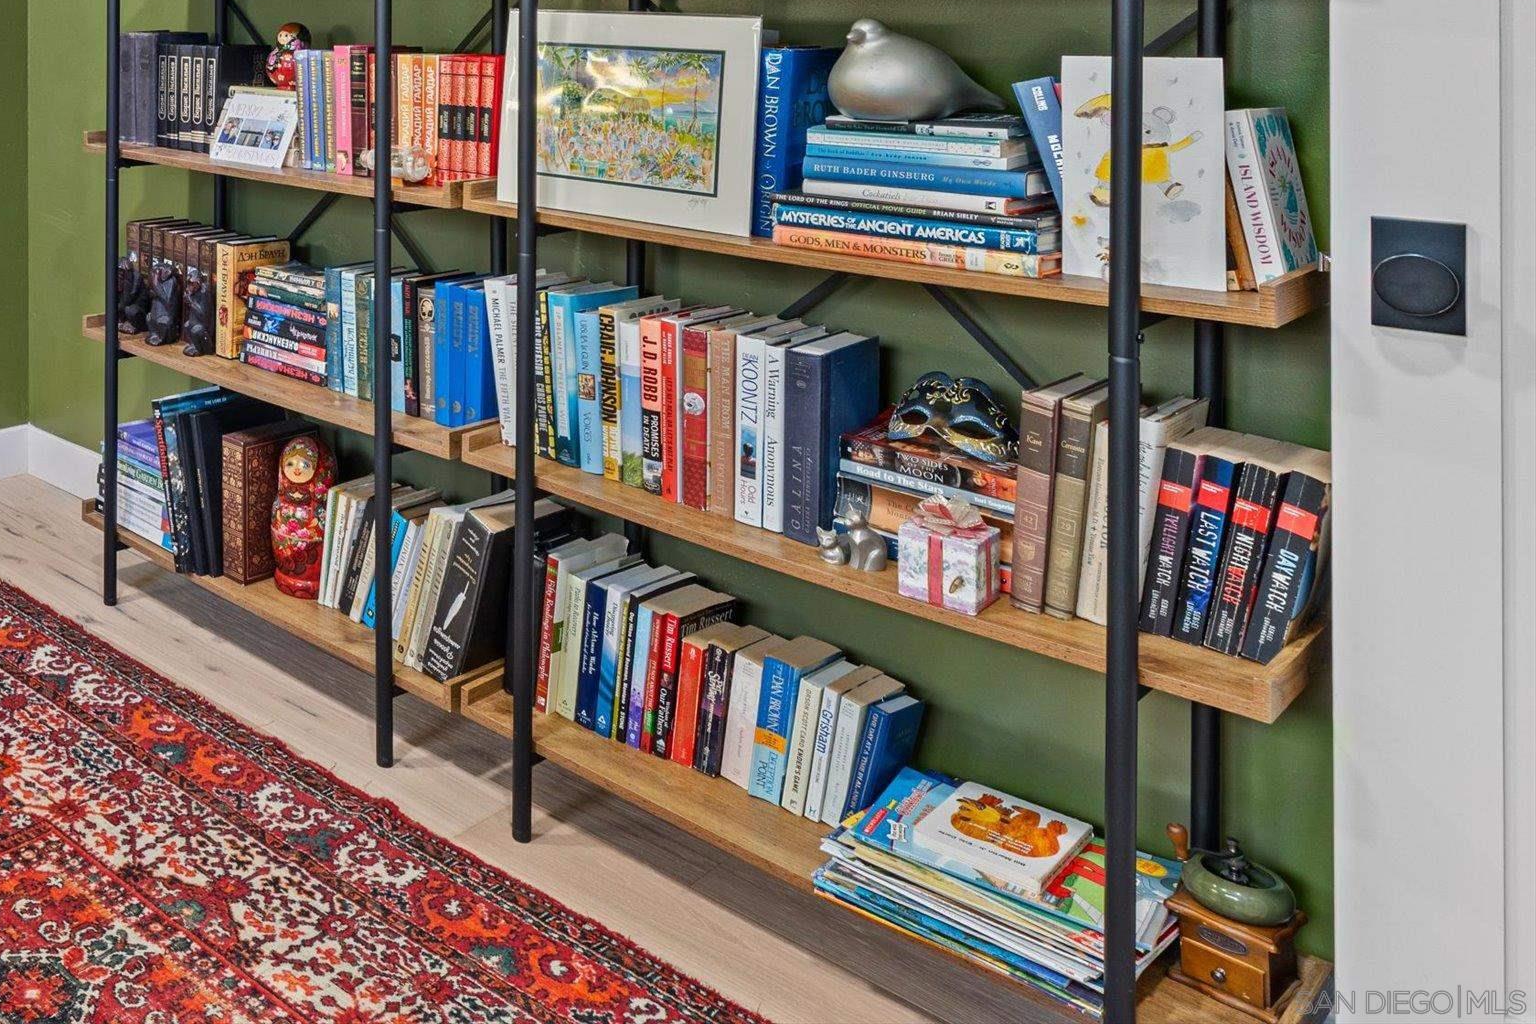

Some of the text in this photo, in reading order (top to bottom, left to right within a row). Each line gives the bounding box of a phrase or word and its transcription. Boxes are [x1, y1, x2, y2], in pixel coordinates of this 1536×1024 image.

[182, 62, 190, 117] Борис Васильев
[194, 63, 202, 119] Борис Васильев
[400, 63, 410, 102] ГАЙДАР
[412, 64, 422, 103] ГАЙДАР
[424, 65, 436, 154] АРКАДИЙ ГАЙДАР
[763, 52, 783, 158] DAN BROWN
[814, 164, 936, 182] RUTH BADER GINSBURG
[758, 174, 776, 232] ORIGIN
[829, 199, 849, 208] RINGS
[851, 202, 880, 210] OFFICIAL
[882, 204, 904, 212] MOVIE
[932, 210, 978, 220] BRIAN SIBLEY
[1238, 164, 1274, 266] ISLAND WISDOM
[780, 210, 986, 244] MYSTERIES OF THE ANCIENT AMERICAS
[237, 248, 286, 263] ДЭН БРАУН
[789, 234, 927, 260] GODS, MEN & MONSTERS
[222, 248, 230, 302] ДЭН БРАУН
[492, 298, 506, 366] MICHAEL PALMER
[600, 314, 617, 424] CRAIG JOHNSON
[643, 368, 658, 403] ROBB
[722, 366, 730, 430] MAN FROM
[740, 359, 758, 424] KOONTZ
[766, 355, 780, 420] A Warning
[536, 382, 548, 432] CHRIS PAVONE
[643, 416, 649, 424] IN
[582, 411, 592, 443] VOICES
[650, 415, 660, 458] PROMISES
[1026, 434, 1042, 448] Kant
[155, 419, 168, 481] Sportfishing
[896, 452, 948, 472] TWO SIDES
[766, 435, 778, 507] Anonymous
[792, 445, 802, 531] GALINA
[856, 466, 944, 495] Road to The Stars
[900, 466, 944, 484] MOON
[740, 479, 748, 505] Hours
[747, 484, 756, 505] Odd
[1023, 514, 1035, 526] 42
[1061, 520, 1072, 531] 29
[1156, 514, 1180, 588] TWILIGHT WATCH
[1187, 511, 1222, 593] LAST WATCH
[1223, 532, 1255, 607] NIGHT WATCH
[1265, 548, 1300, 614] DAY WATCH
[1148, 589, 1160, 620] LUKYANENKO
[1160, 598, 1169, 617] SERGEI
[1182, 600, 1195, 634] LUKYANENKO
[1192, 610, 1202, 630] SERGEI
[1226, 618, 1234, 636] SERGEI
[1266, 624, 1276, 642] SERGEI
